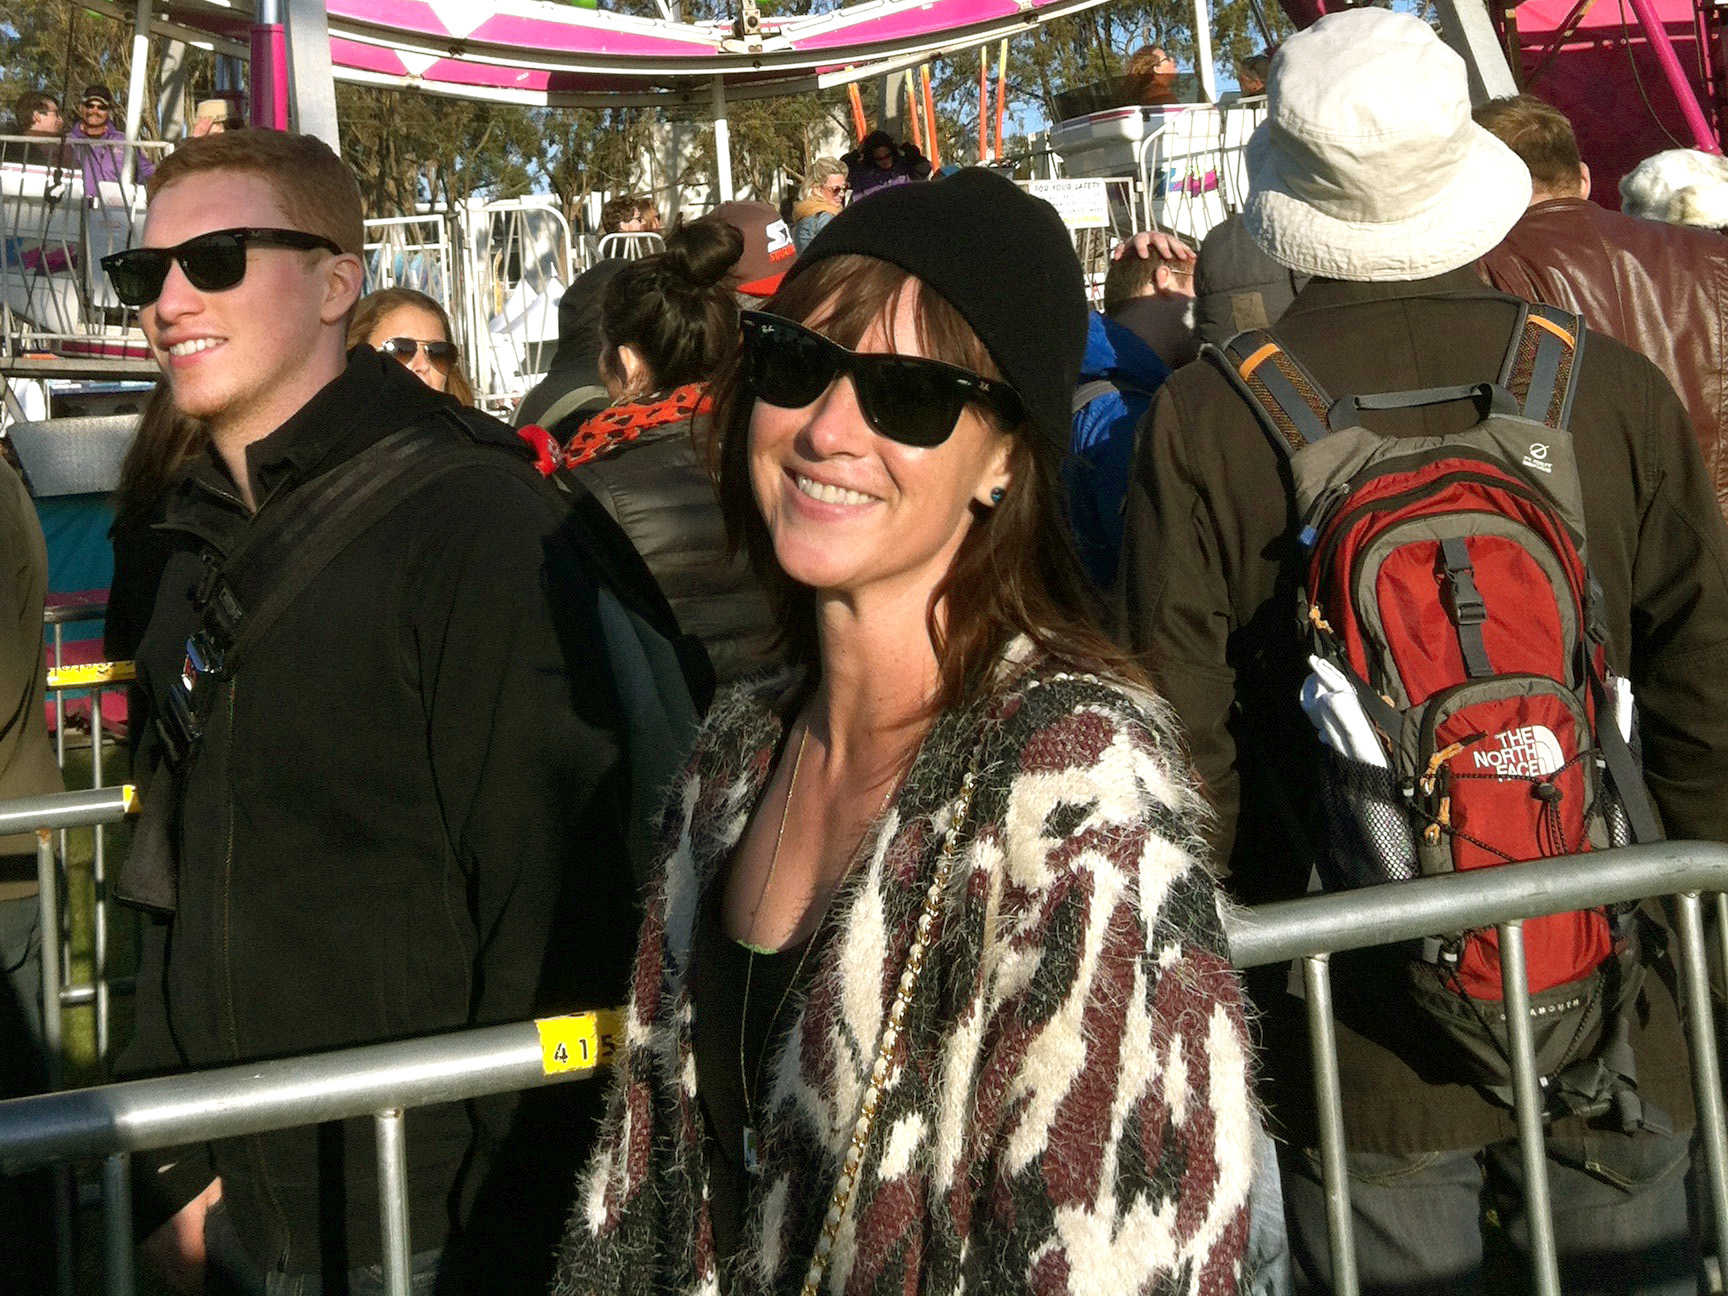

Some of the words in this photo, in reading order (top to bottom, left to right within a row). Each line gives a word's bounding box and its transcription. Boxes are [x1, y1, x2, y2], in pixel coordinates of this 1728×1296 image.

[1052, 182, 1072, 192] YOUR
[1494, 726, 1536, 749] THE
[1473, 742, 1538, 769] NORTH
[1496, 759, 1540, 782] FACE
